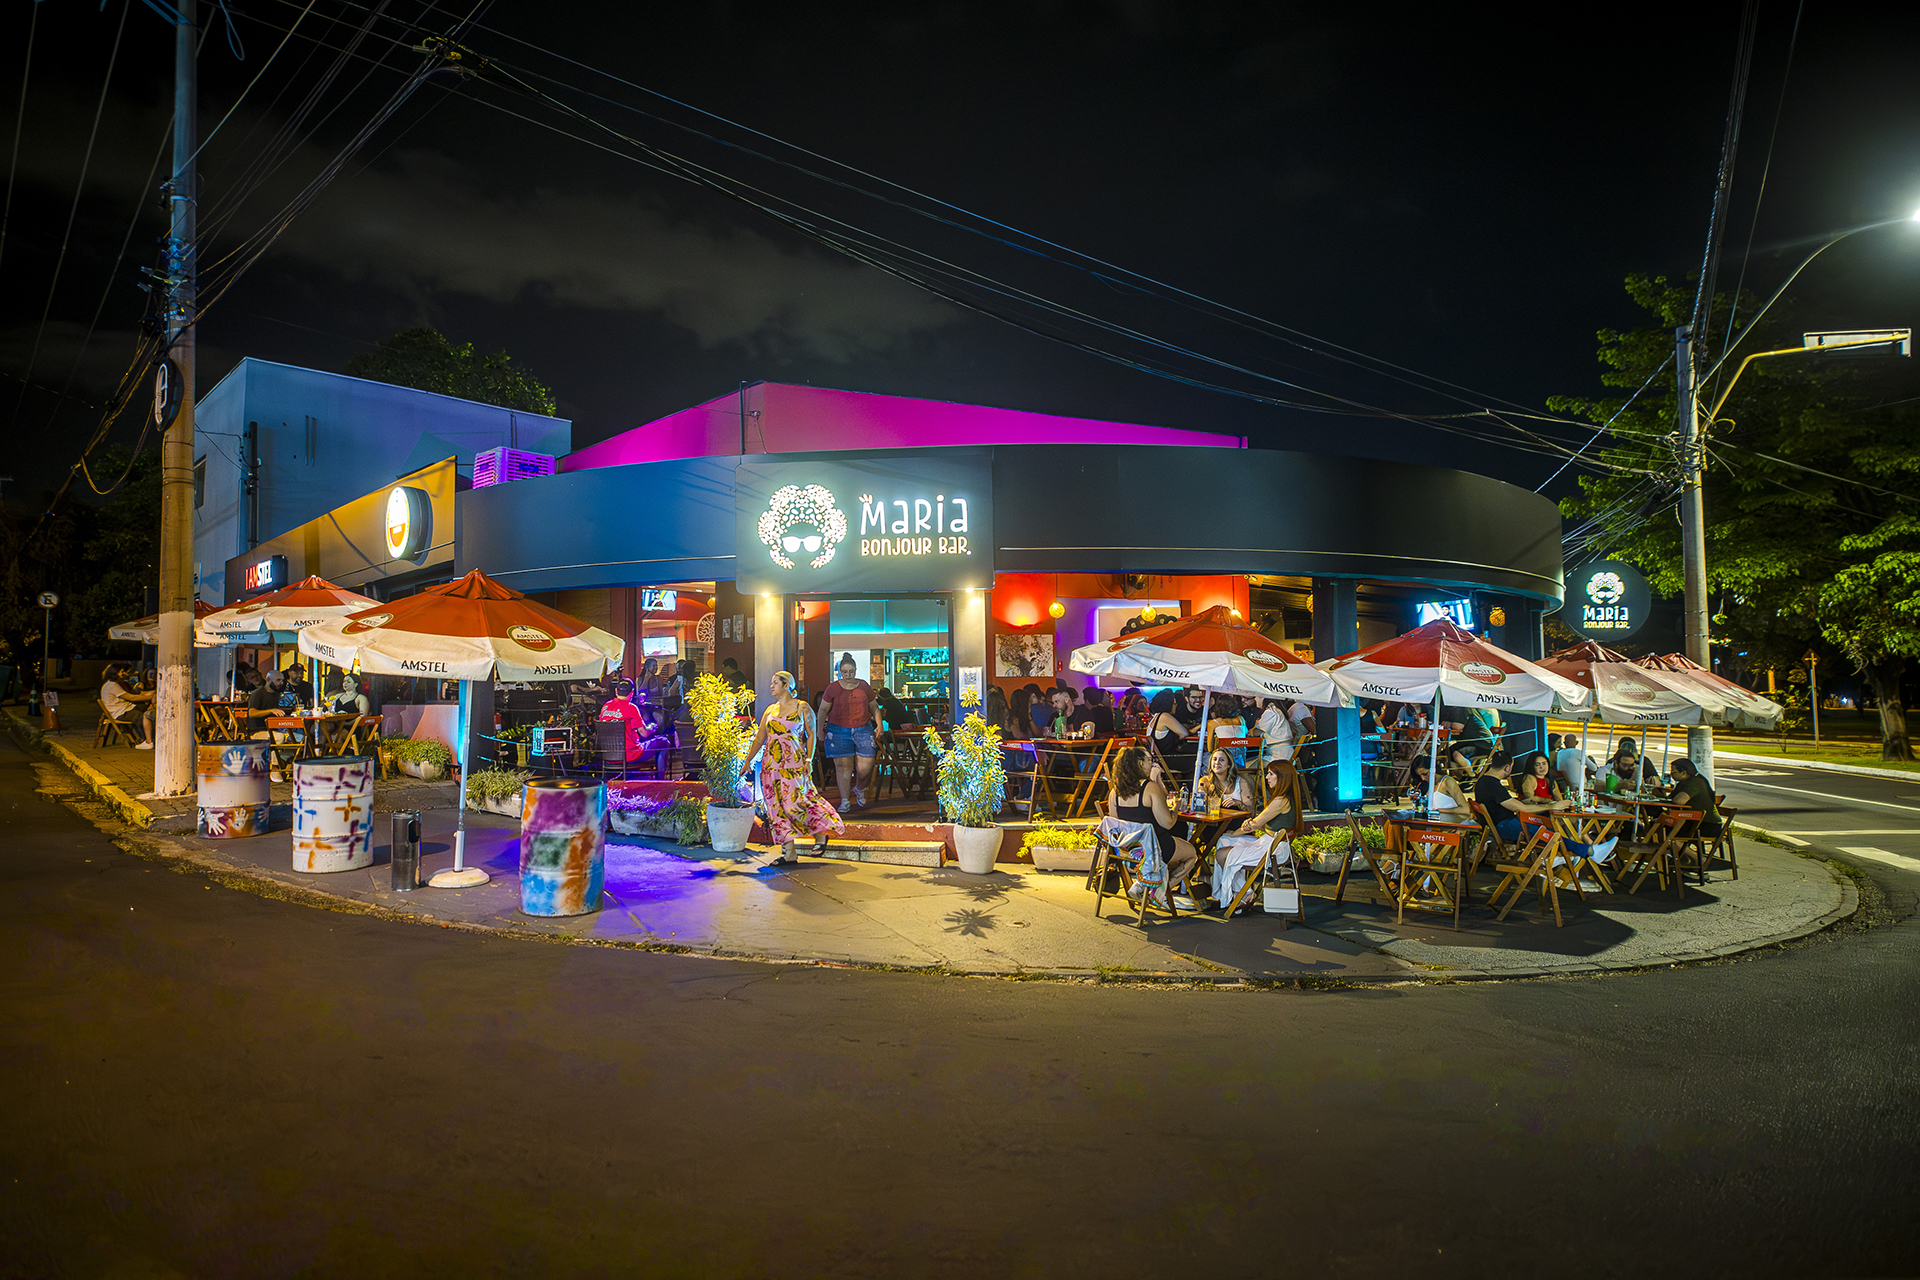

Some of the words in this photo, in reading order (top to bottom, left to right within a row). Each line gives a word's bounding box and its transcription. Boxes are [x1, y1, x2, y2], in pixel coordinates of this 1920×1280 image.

[220, 621, 242, 629] AMSTEL
[294, 619, 324, 627] AMSTE
[516, 632, 545, 640] AMSTEL
[315, 641, 336, 659] AMSTEL
[400, 659, 448, 674] AMSTEL
[533, 664, 573, 675] AMSTEL
[1148, 666, 1191, 679] AMSTEL
[1262, 681, 1304, 695] AMSTEL
[1361, 682, 1402, 697] AMSTEL
[1475, 693, 1520, 706] AMSTEL
[1633, 712, 1671, 721] AMSTEL
[1421, 834, 1446, 842] AMSTEL
